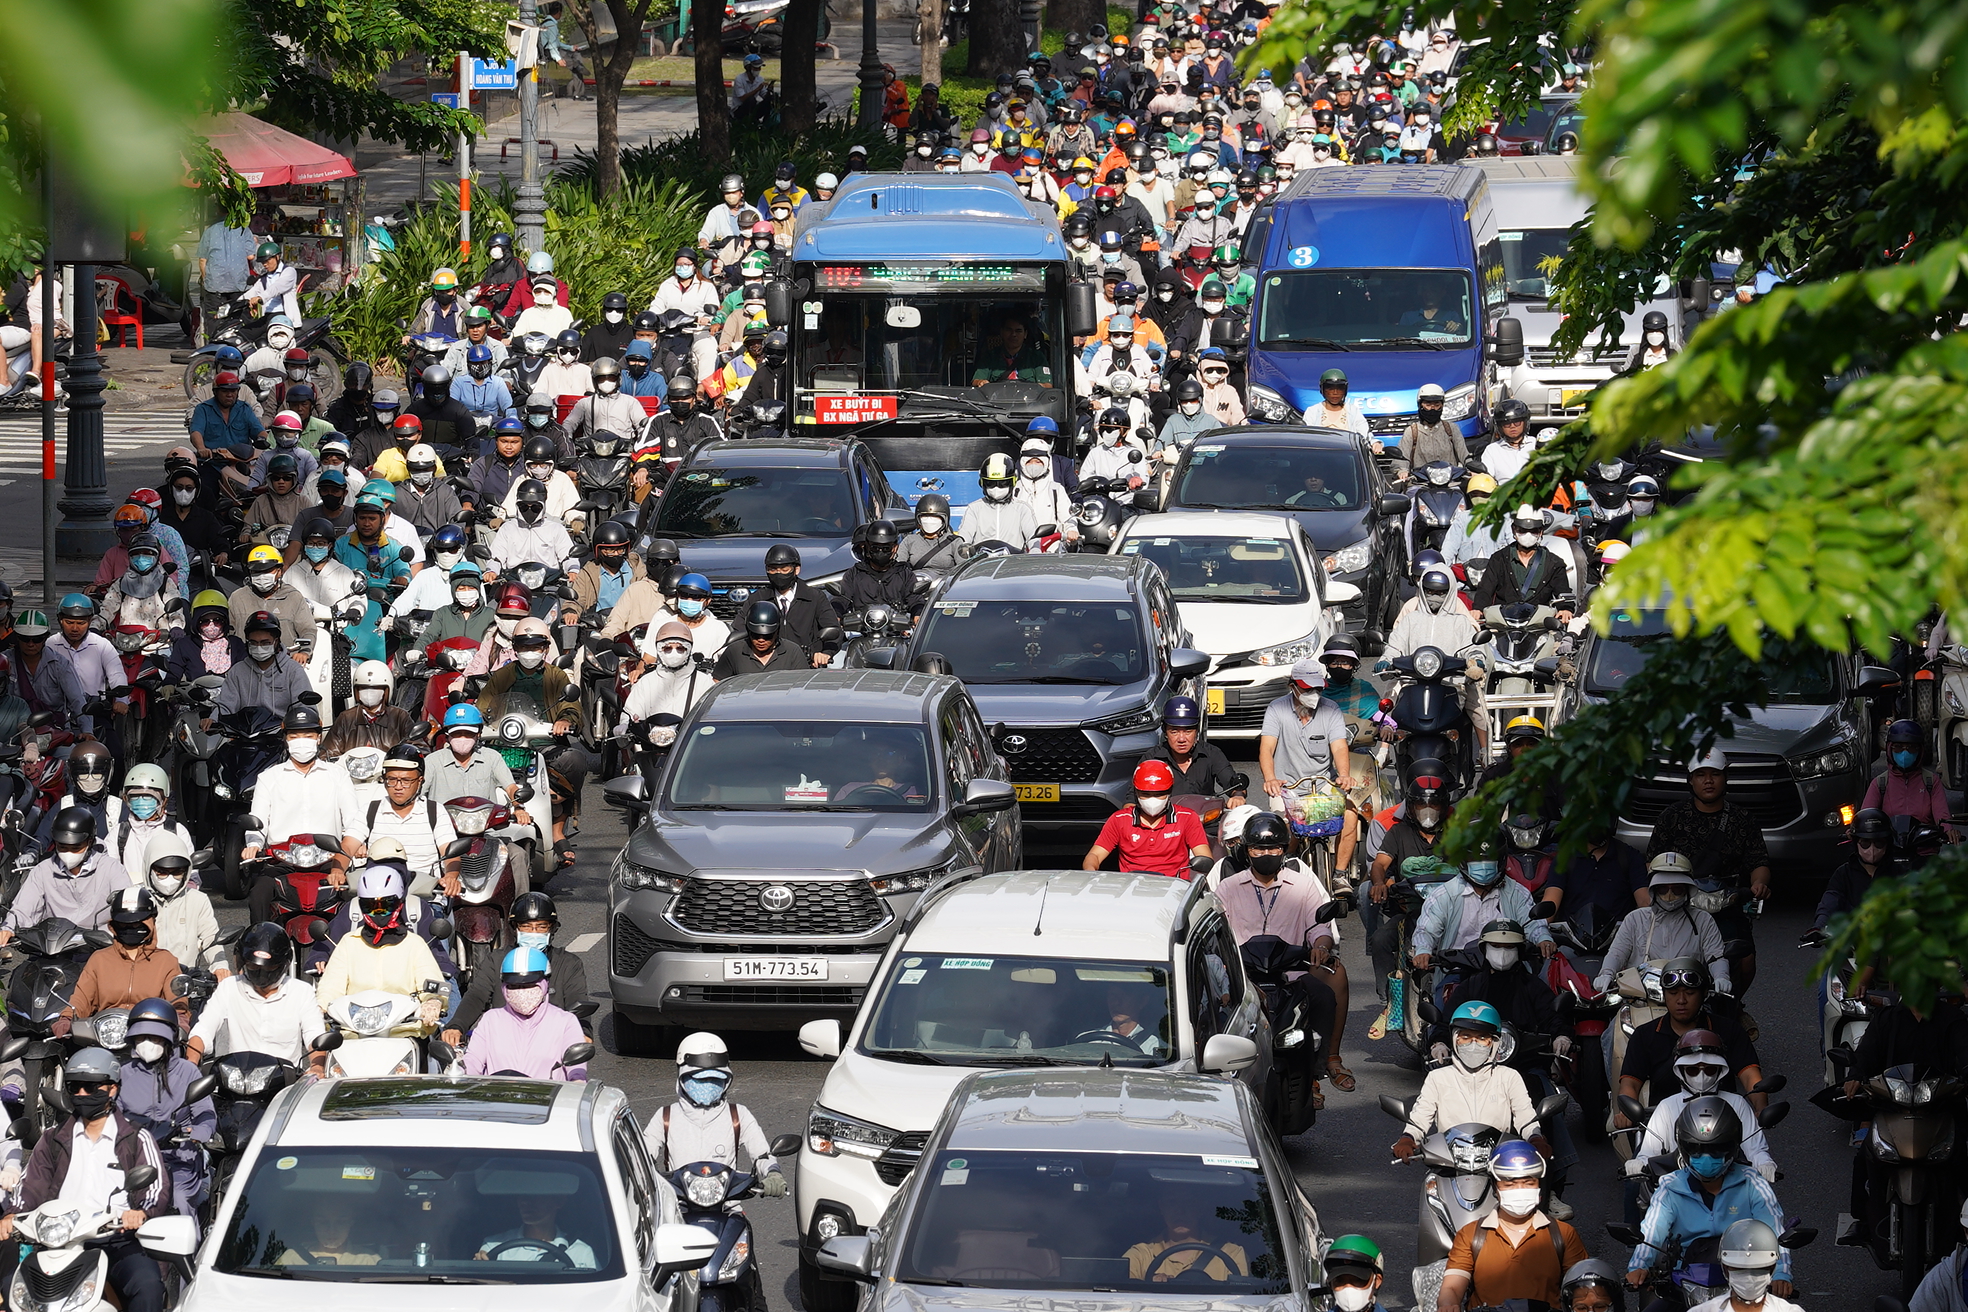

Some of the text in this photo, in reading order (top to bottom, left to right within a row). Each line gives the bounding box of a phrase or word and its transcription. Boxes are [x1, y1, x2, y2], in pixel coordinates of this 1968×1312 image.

[476, 72, 513, 86] HOÀNG VĂN THỤ
[1294, 247, 1313, 266] 3
[830, 397, 882, 409] XE BUÝT ĐI
[823, 410, 889, 422] BX NGÃ TƯ GA
[733, 961, 819, 976] 51M-773.54
[970, 959, 992, 967] ĐỒNG
